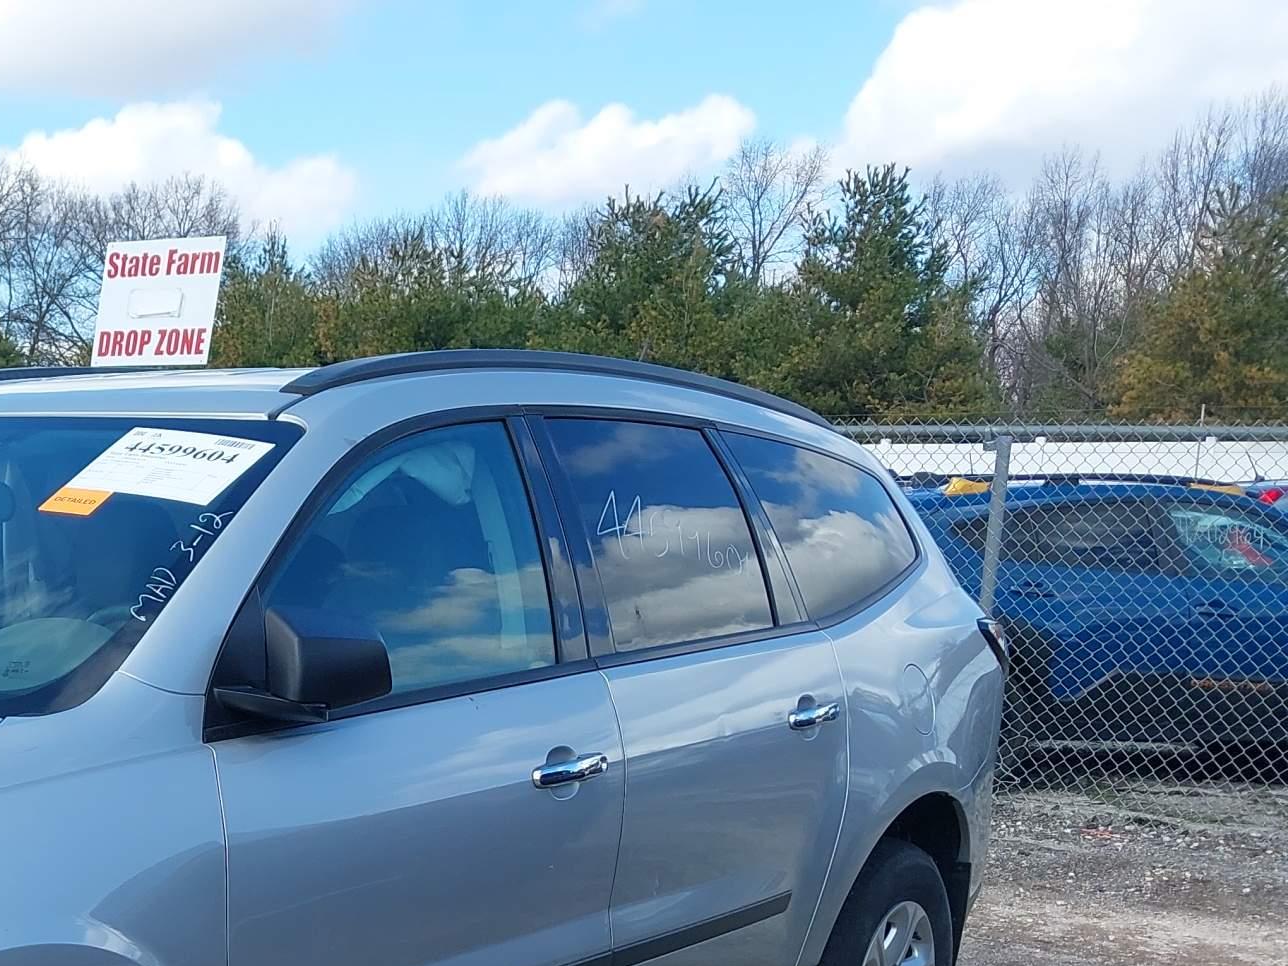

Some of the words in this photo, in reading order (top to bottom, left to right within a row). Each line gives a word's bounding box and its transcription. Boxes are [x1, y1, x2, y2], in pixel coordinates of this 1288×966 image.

[107, 252, 162, 279] State
[166, 249, 221, 276] Farm
[97, 330, 152, 357] DROP
[154, 328, 207, 356] ZONE
[124, 441, 241, 465] 44599604
[53, 495, 97, 506] DETAILED
[130, 567, 177, 621] MAD
[169, 511, 234, 562] 3-12
